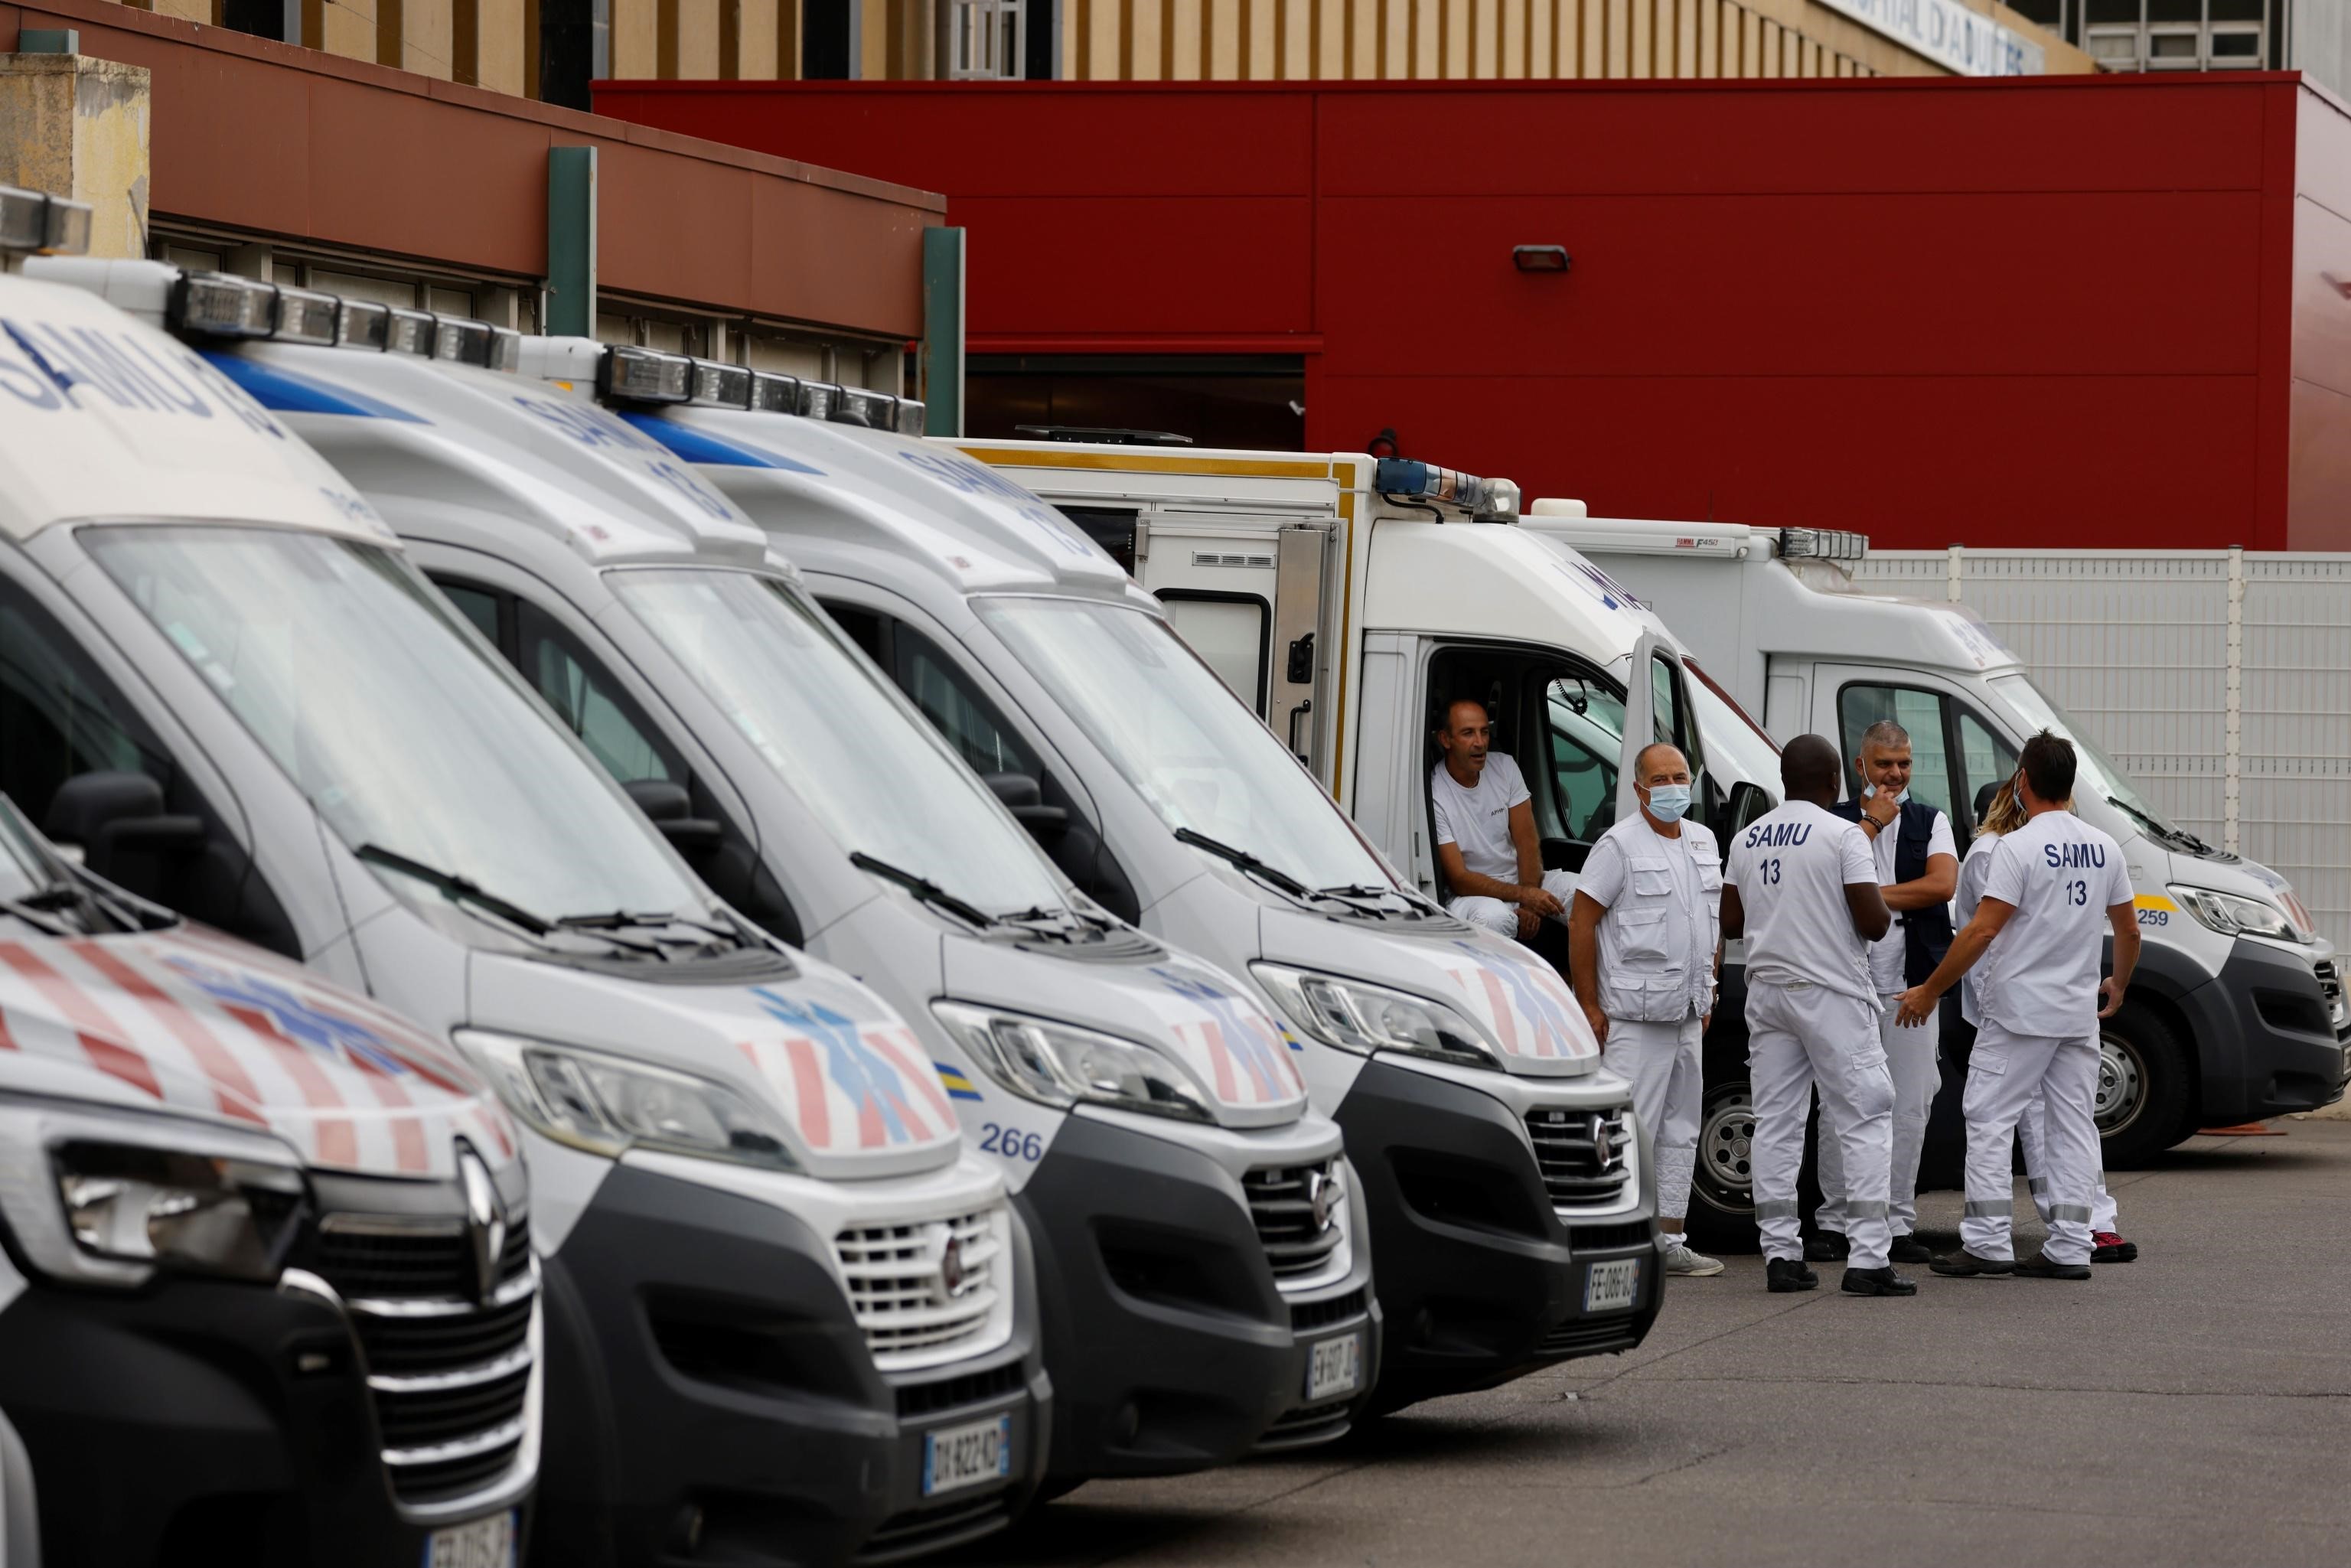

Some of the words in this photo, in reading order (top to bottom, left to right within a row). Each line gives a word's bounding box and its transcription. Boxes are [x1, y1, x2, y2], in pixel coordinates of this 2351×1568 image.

[1746, 823, 1812, 849] SAMU
[2044, 843, 2105, 868] SAMU
[1760, 858, 1781, 885] 13
[2066, 880, 2087, 906] 13
[2137, 908, 2169, 927] 259
[980, 1122, 1042, 1162] 266
